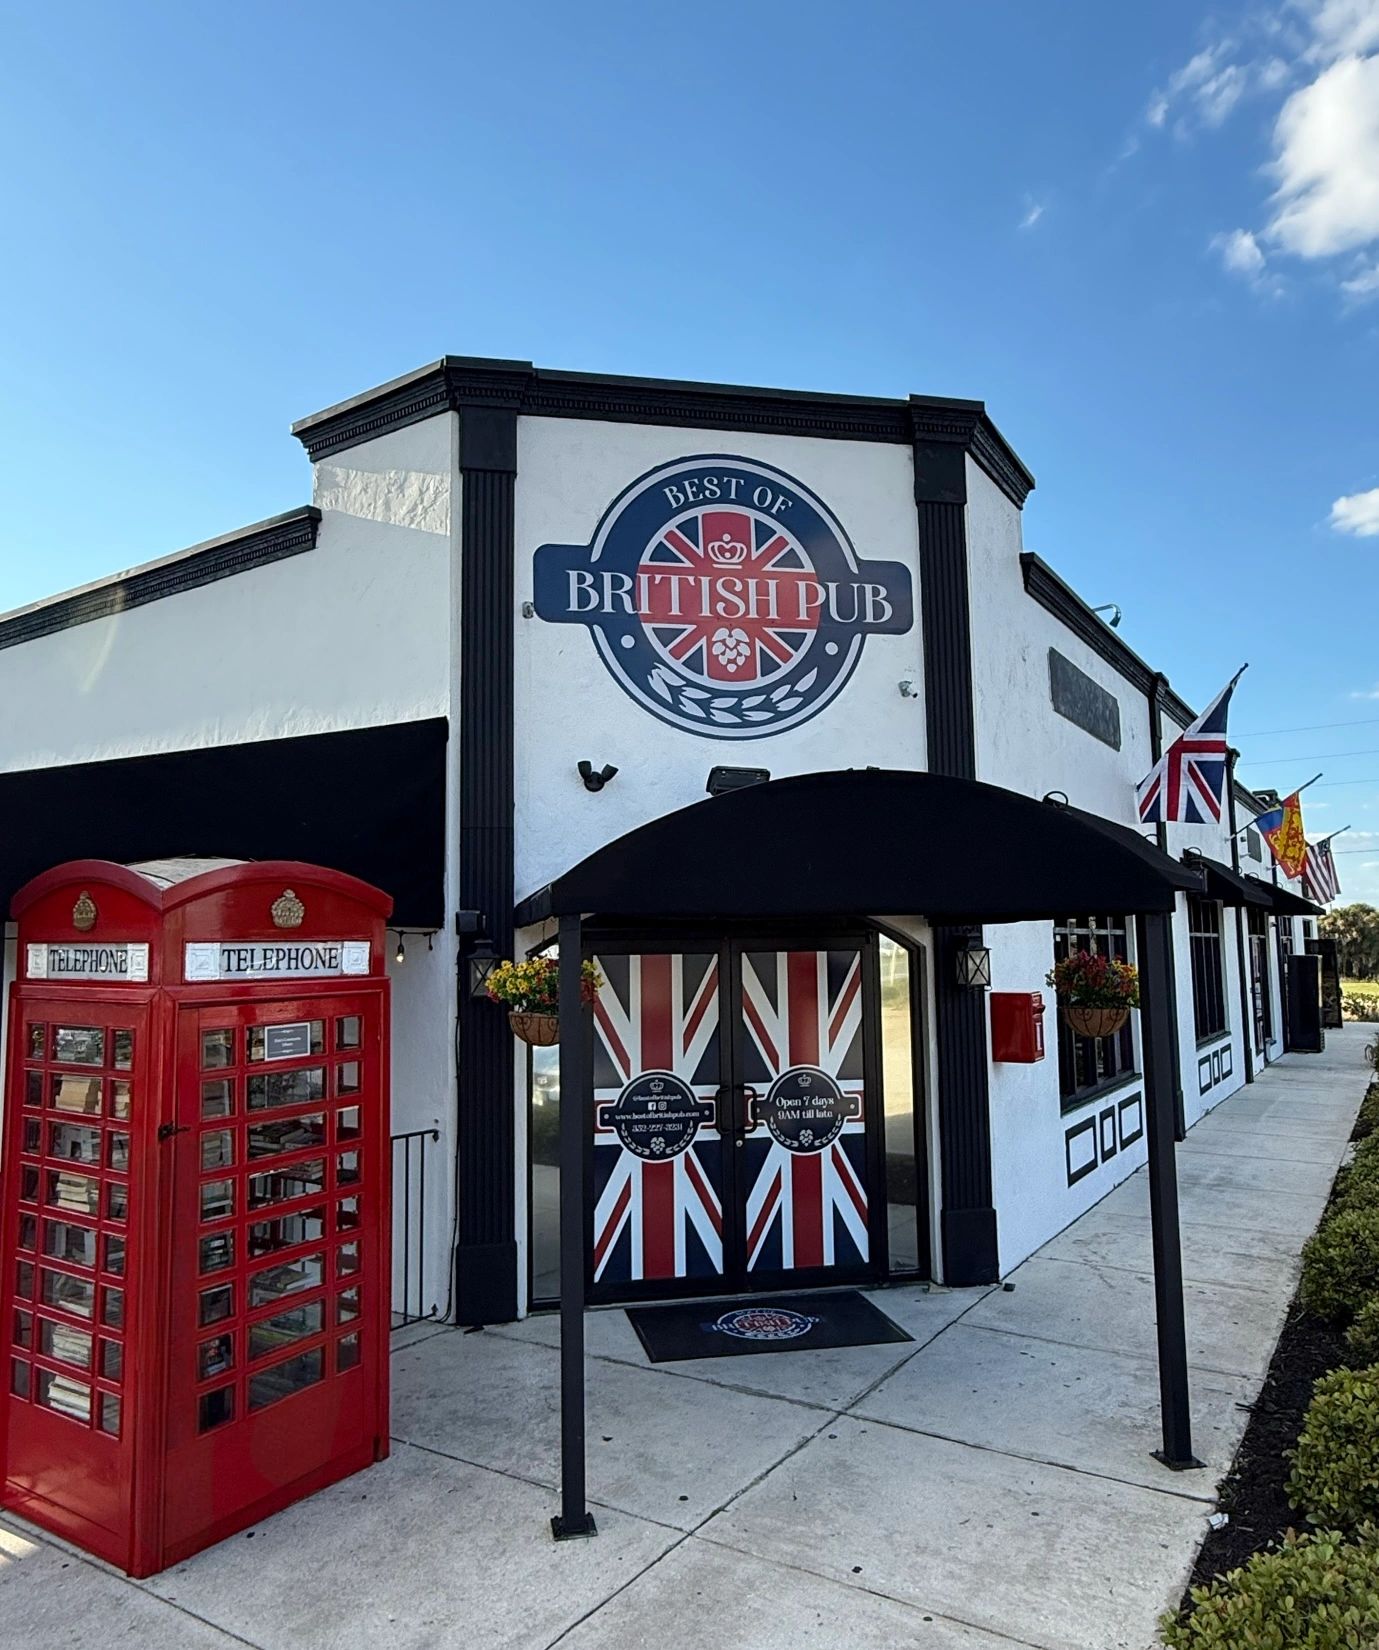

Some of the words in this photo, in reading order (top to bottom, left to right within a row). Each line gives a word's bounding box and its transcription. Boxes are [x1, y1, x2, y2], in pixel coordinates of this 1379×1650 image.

[662, 476, 745, 509] BEST
[753, 486, 793, 515] OF
[565, 569, 781, 621] BRITISH
[795, 580, 893, 624] PUB
[49, 948, 128, 974] TELEPHONE
[222, 946, 340, 973] TELEPHONE
[775, 1096, 802, 1109] Open
[803, 1095, 811, 1106] 7
[811, 1095, 835, 1109] days
[777, 1109, 800, 1120] 9AM
[802, 1108, 814, 1119] till
[816, 1108, 833, 1118] late
